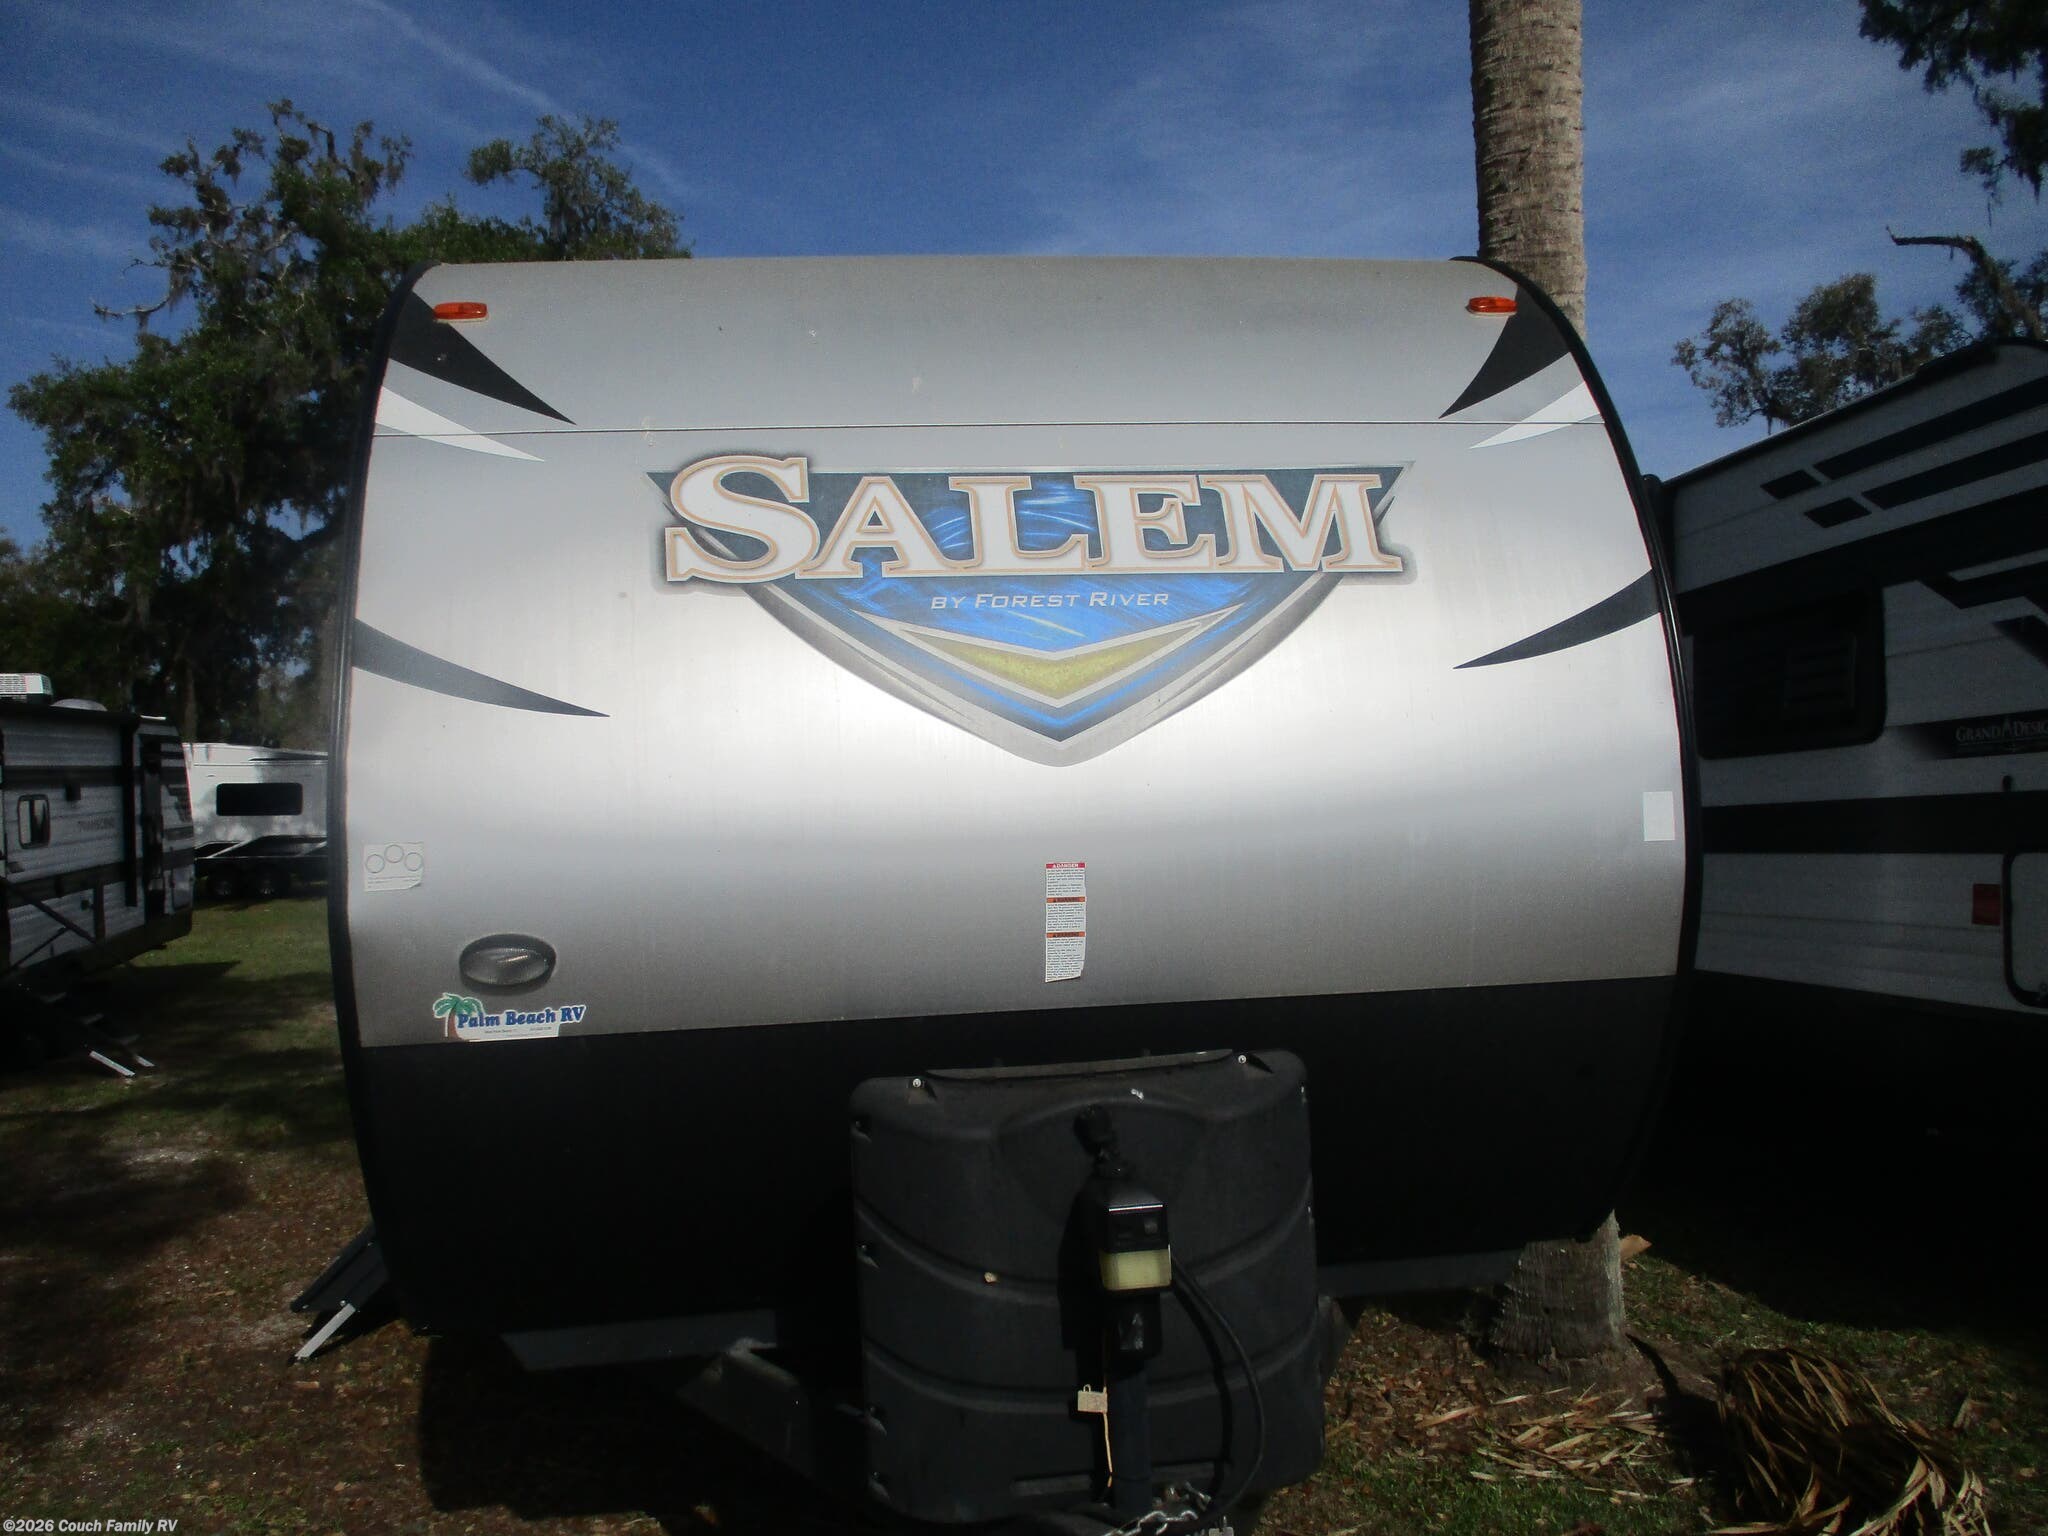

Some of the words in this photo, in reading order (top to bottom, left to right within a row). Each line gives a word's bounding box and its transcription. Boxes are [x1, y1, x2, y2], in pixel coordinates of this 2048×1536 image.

[666, 456, 1404, 583] SALEM
[930, 596, 967, 609] BY
[974, 593, 1081, 609] FOREST
[1088, 591, 1170, 607] RIVER
[1954, 725, 2001, 742] GRAND
[457, 1013, 500, 1029] Palm
[505, 1008, 556, 1026] Beach
[560, 1005, 586, 1022] RV
